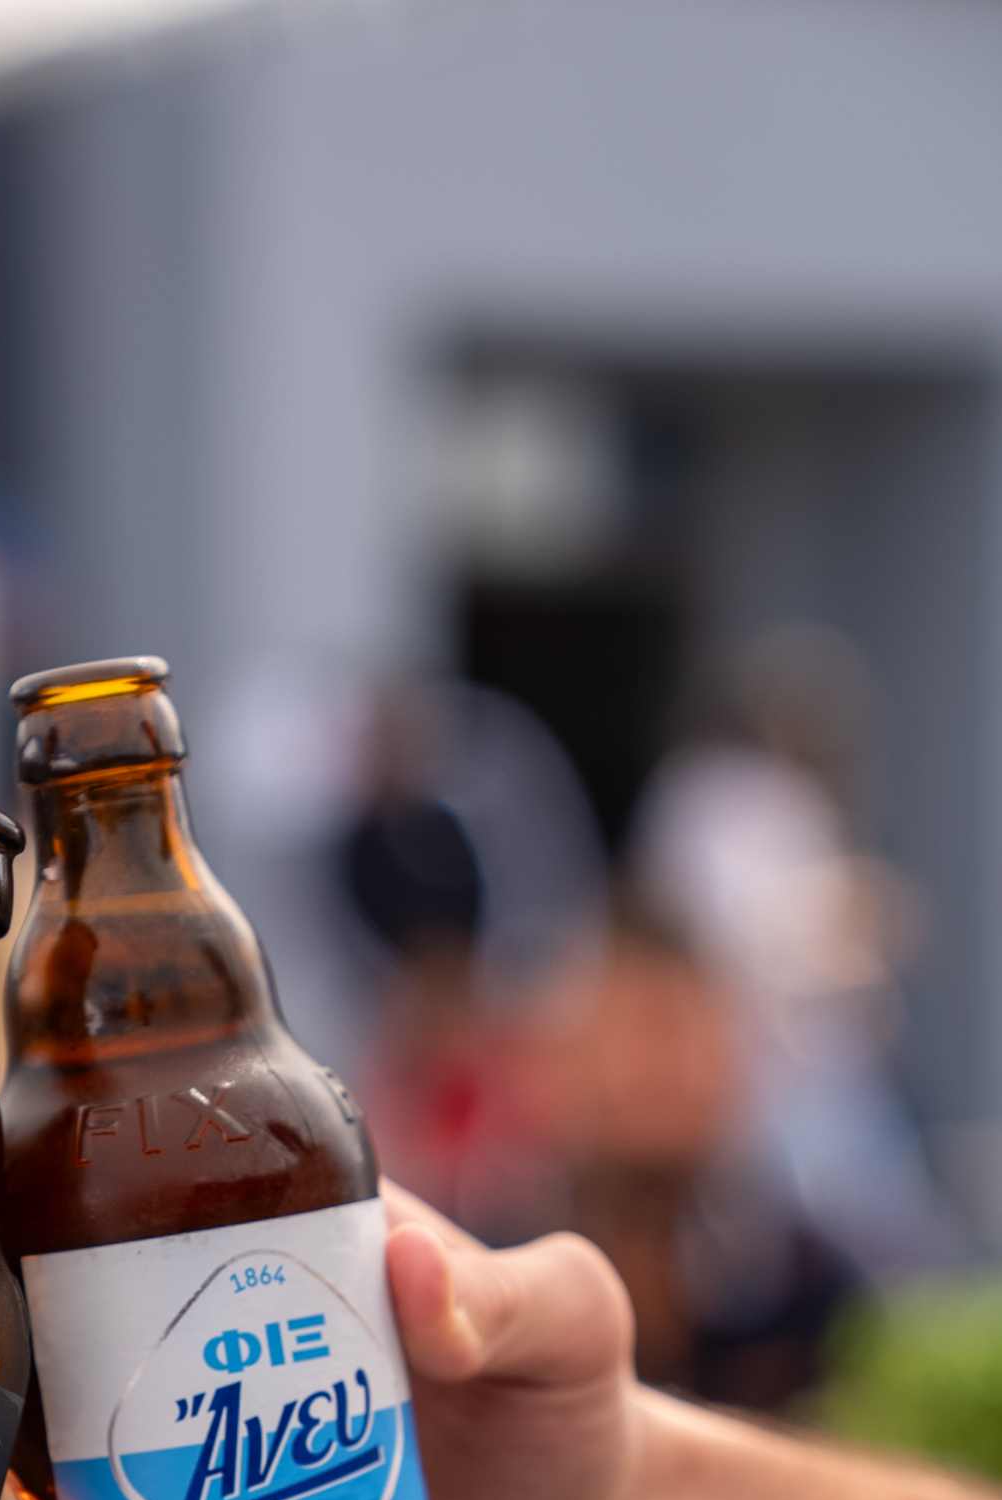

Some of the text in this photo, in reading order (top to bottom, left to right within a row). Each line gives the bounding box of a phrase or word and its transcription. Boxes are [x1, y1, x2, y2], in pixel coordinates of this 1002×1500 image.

[75, 1080, 251, 1168] FIX
[229, 1265, 287, 1294] 1864
[203, 1314, 331, 1374] ΦΙΞ
